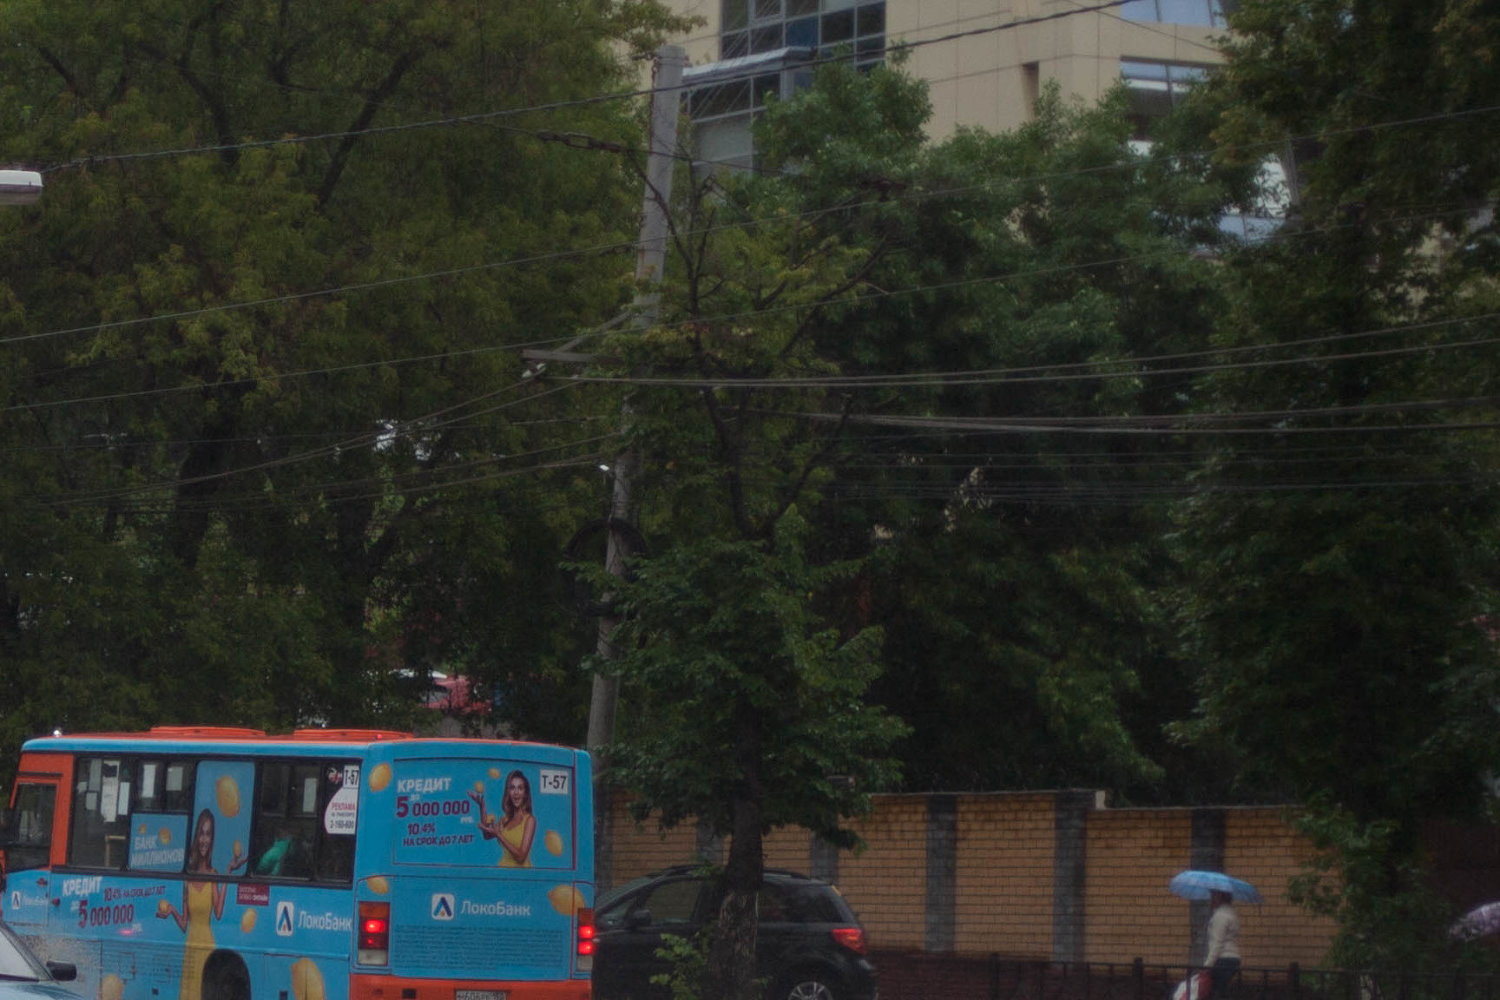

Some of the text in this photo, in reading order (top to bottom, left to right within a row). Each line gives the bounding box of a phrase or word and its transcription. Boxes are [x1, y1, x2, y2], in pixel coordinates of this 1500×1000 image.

[397, 777, 451, 793] КРЕДИТ
[541, 774, 567, 790] Т-57
[395, 796, 471, 818] 5 000 000
[62, 875, 103, 897] КРЕДИТ
[90, 906, 112, 926] 000
[112, 903, 135, 924] 000
[461, 899, 532, 917] ЛокоБанк
